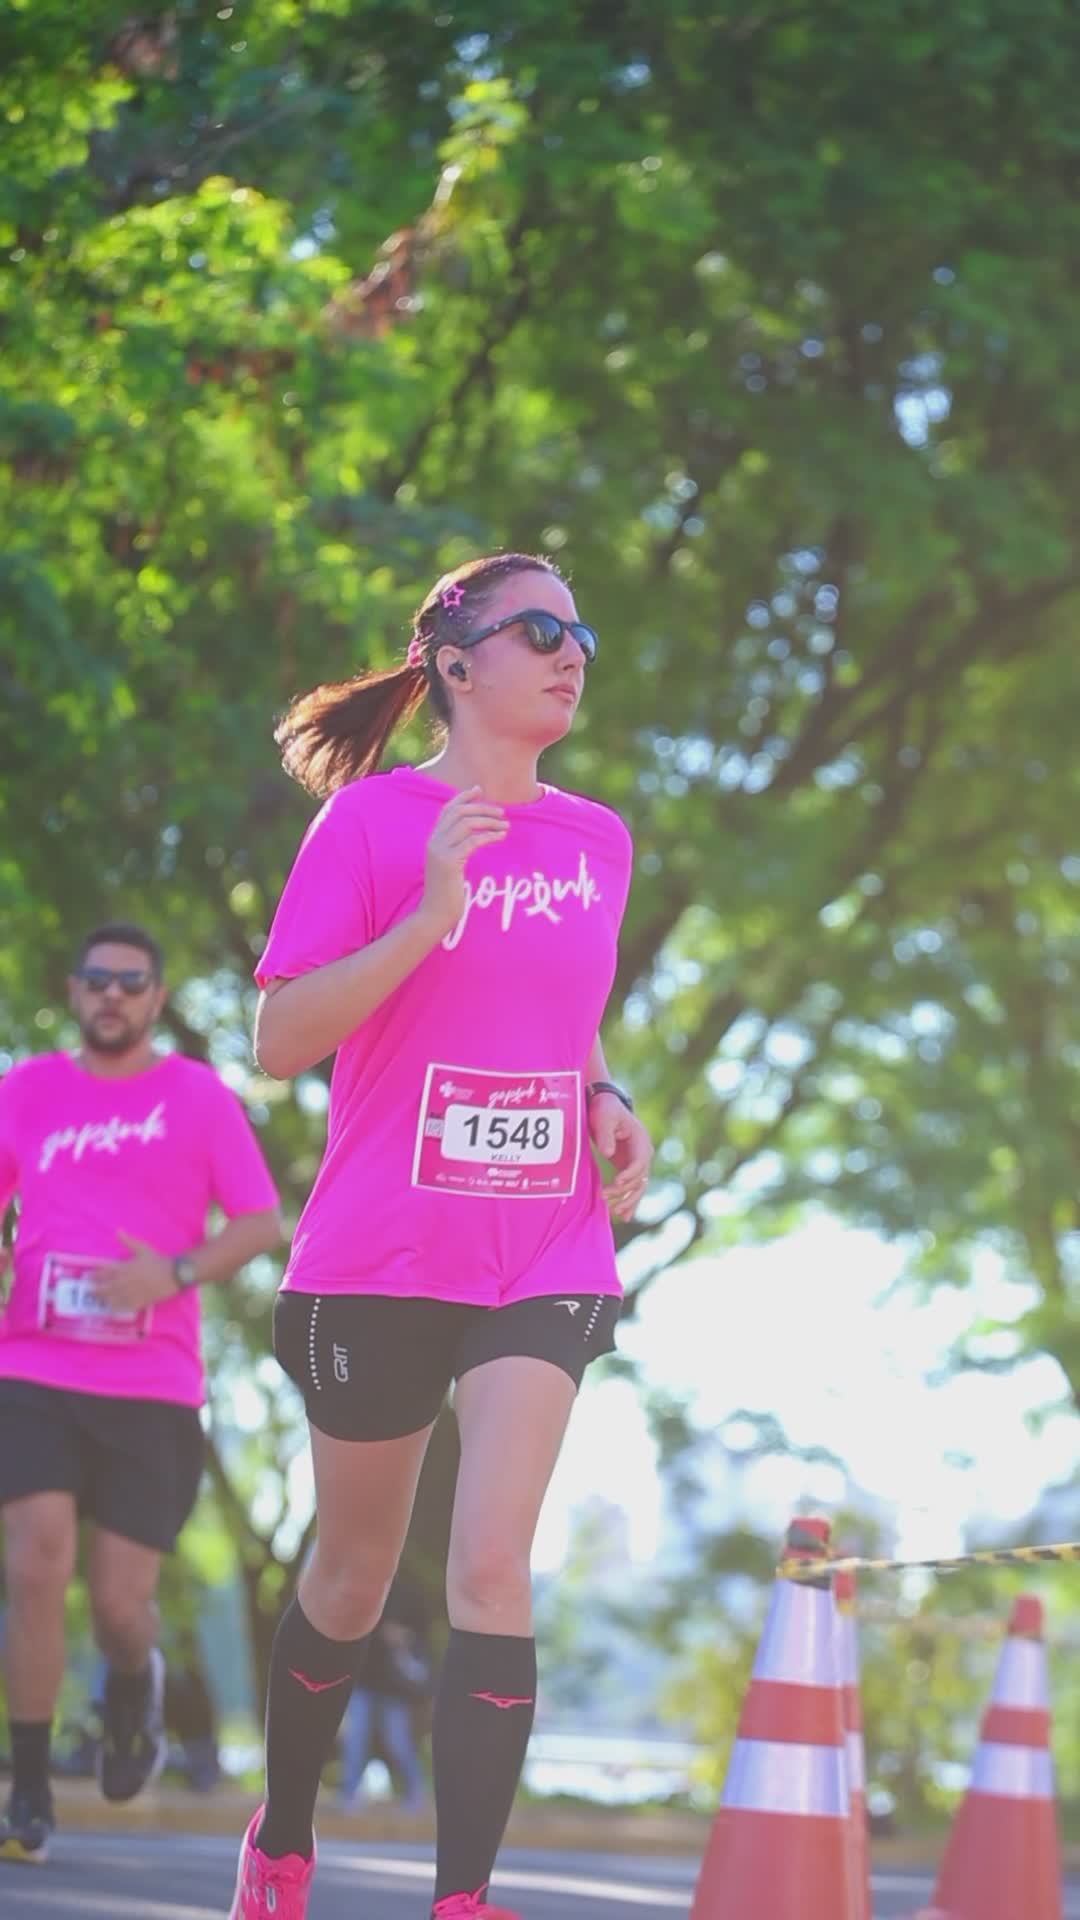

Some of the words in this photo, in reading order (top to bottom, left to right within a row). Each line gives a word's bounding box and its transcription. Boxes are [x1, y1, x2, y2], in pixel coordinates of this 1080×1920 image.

[463, 1114, 550, 1150] 1548
[490, 1153, 521, 1162] KELLY
[333, 1342, 348, 1382] GRIT
